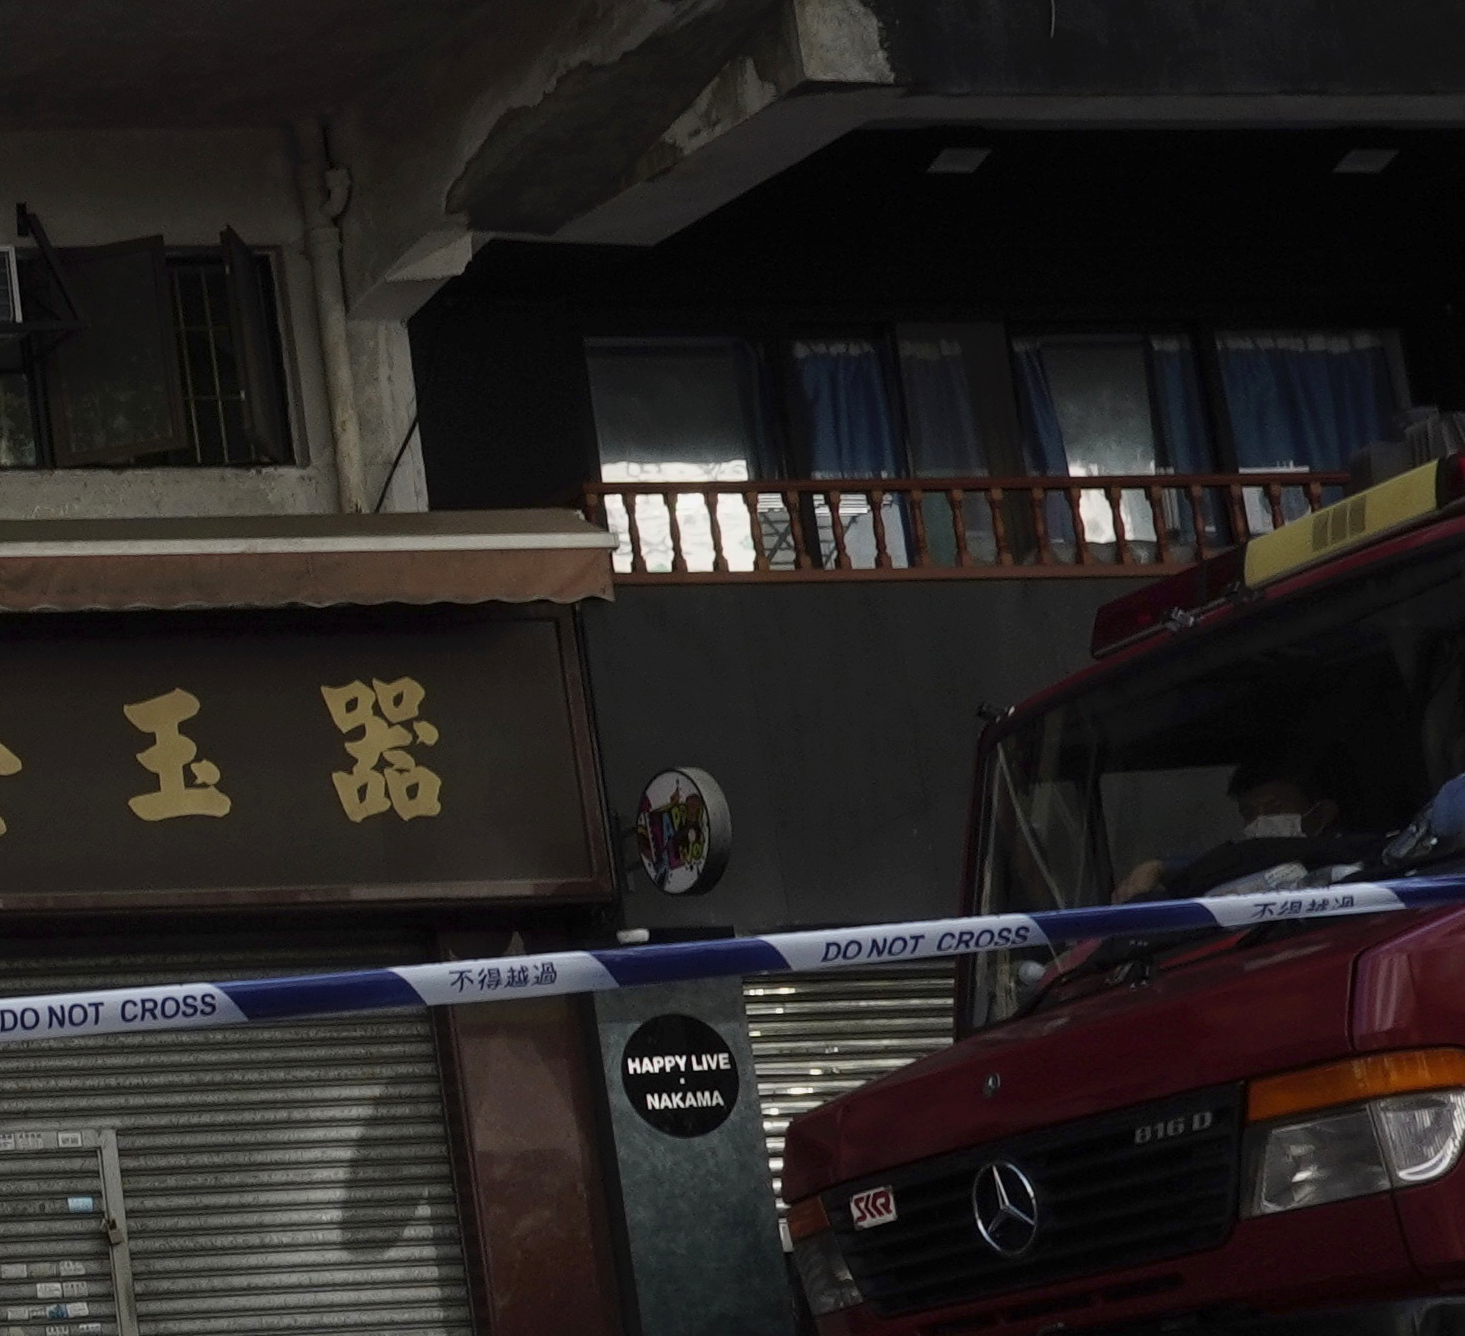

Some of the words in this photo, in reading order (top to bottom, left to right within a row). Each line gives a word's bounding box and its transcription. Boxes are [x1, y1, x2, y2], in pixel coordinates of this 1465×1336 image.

[821, 940, 862, 962] DO
[867, 935, 925, 959] NOT
[936, 926, 1031, 952] CROSS
[448, 961, 558, 993] 不得越過
[0, 1007, 40, 1033] DO
[47, 1002, 105, 1029] NOT
[120, 993, 217, 1023] CROSS
[627, 1054, 687, 1074] HAPPY
[691, 1052, 732, 1072] LIVE
[645, 1089, 725, 1111] NAKAMA
